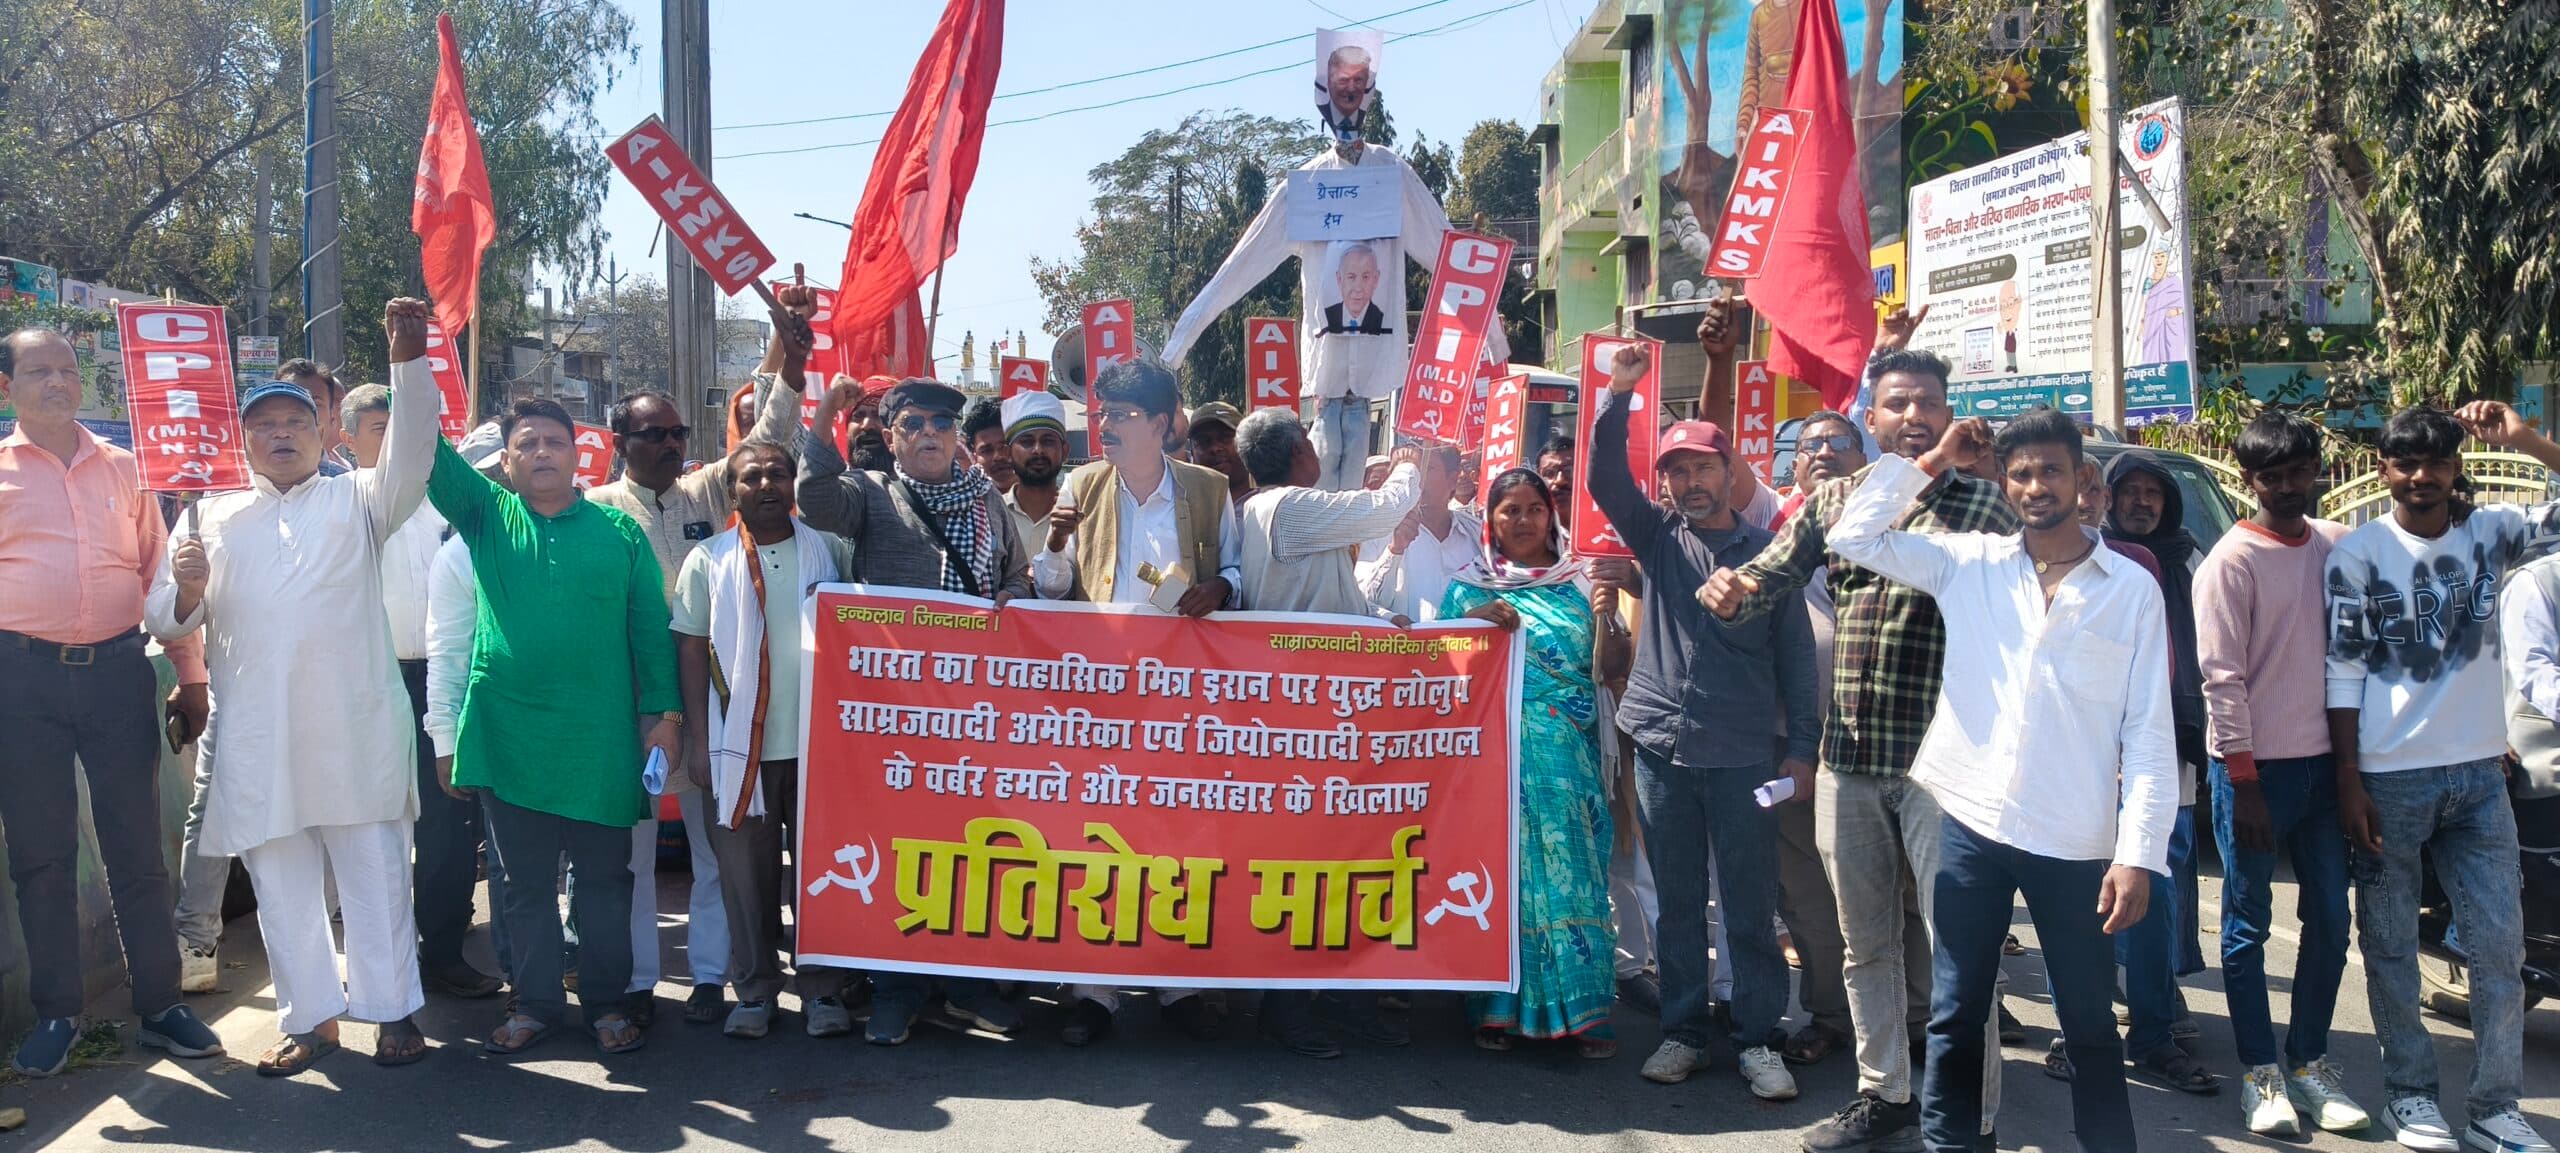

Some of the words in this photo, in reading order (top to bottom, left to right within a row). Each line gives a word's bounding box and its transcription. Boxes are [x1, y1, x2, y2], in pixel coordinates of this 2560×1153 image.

[626, 132, 759, 281] AIKMKS
[1717, 113, 1795, 272] AIKMKS
[1972, 164, 2010, 185] सामाजिक
[836, 605, 906, 626] इन्कलाब
[912, 605, 989, 632] जिन्दाबाद
[1269, 631, 1363, 653] साम्राज्यवादी
[1365, 633, 1425, 656] अमेरिका
[848, 645, 926, 682] भारत
[931, 651, 979, 685] का
[984, 652, 1131, 695] एतहासिक
[1136, 656, 1196, 698] मित्र
[1200, 668, 1273, 705] इरान
[1279, 672, 1320, 705] पर
[1326, 675, 1387, 718] युद्ध
[1391, 668, 1473, 716] लोलुप
[837, 699, 1001, 743] साम्रजवादी
[1008, 705, 1136, 751] अमेरिका
[1140, 713, 1192, 754] एवं
[1195, 714, 1363, 763] जियोनवादी
[1367, 726, 1483, 766] इजरायल
[882, 750, 917, 792] के
[923, 755, 988, 799] वर्बर
[994, 761, 1073, 803] हमले
[1080, 764, 1142, 808] और
[1147, 770, 1278, 815] जनसंहार
[1282, 774, 1316, 815] के
[1322, 775, 1431, 816] खिलाफ
[890, 816, 1225, 948] प्रतिरोध
[1248, 823, 1426, 950] मार्च
